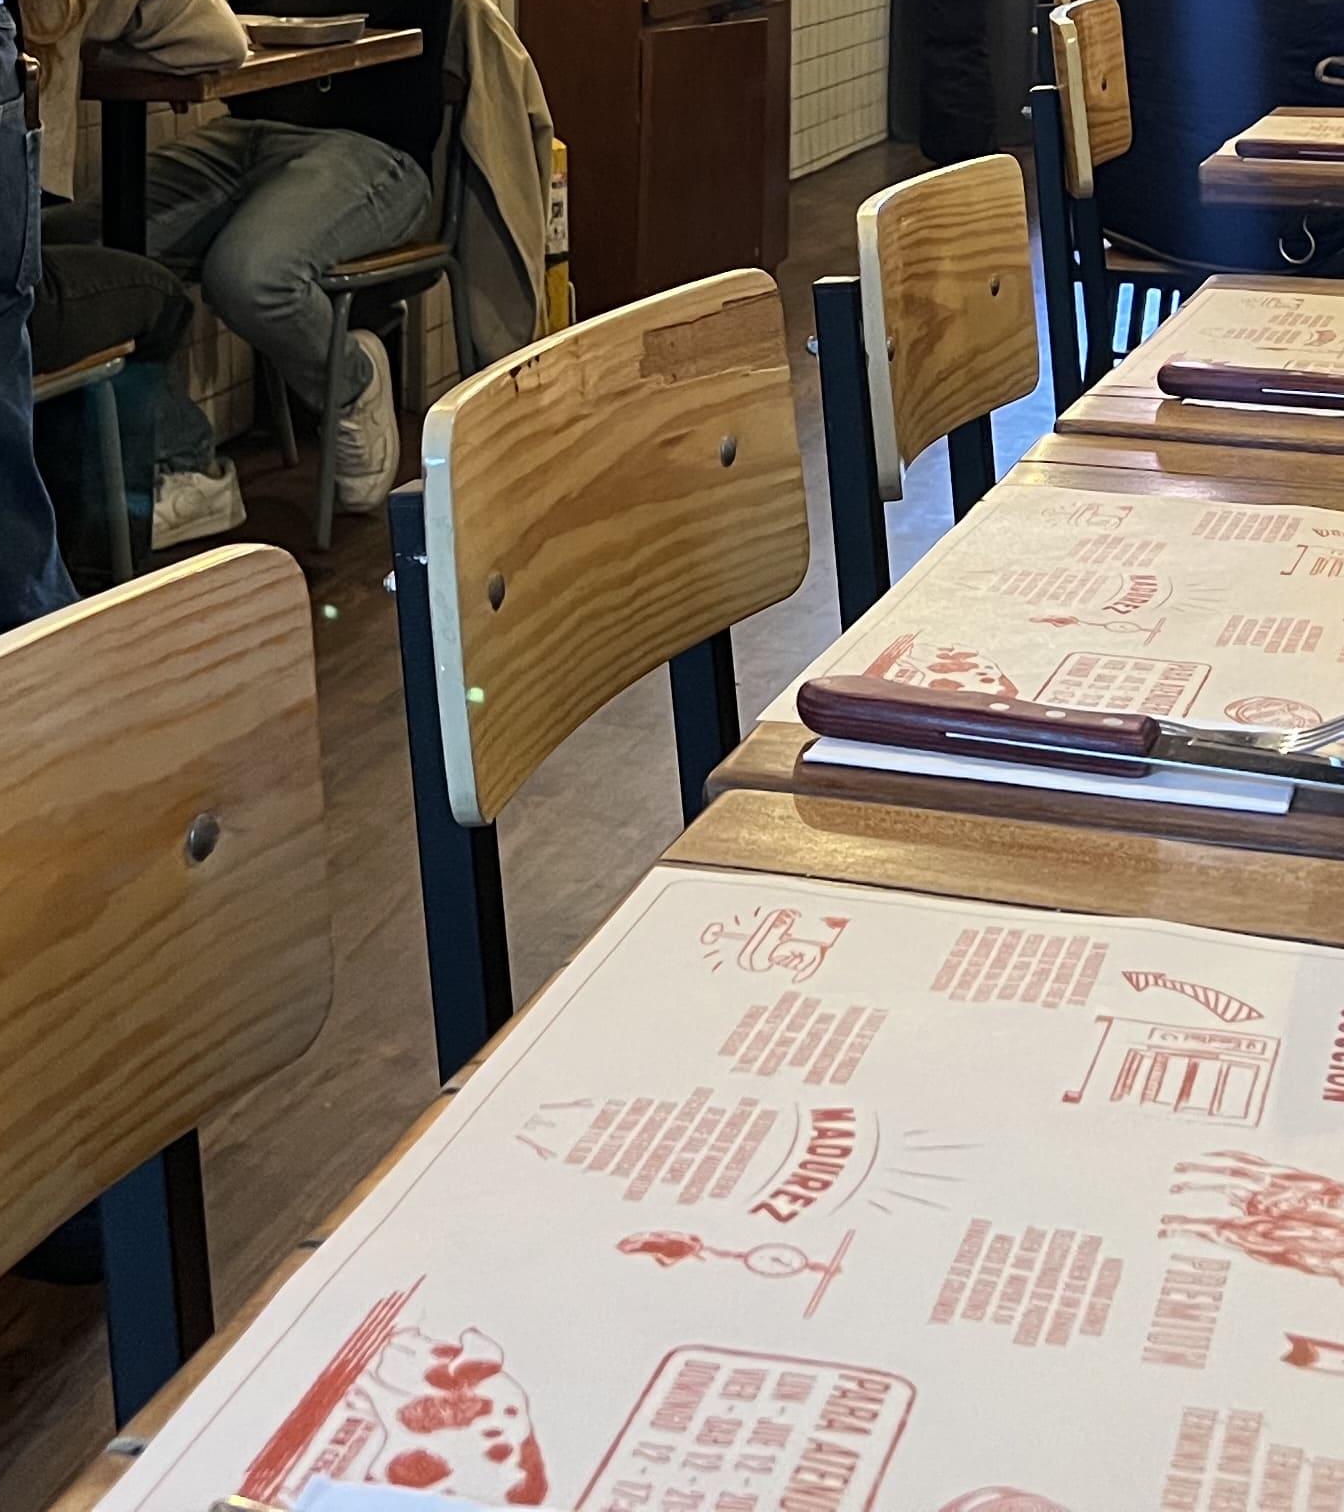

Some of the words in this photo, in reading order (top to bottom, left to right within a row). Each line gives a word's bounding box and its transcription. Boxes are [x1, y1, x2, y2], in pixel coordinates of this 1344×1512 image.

[748, 1107, 856, 1223] MADUREZ
[1140, 1253, 1231, 1369] PREMIUM
[814, 1373, 892, 1436] PARA
